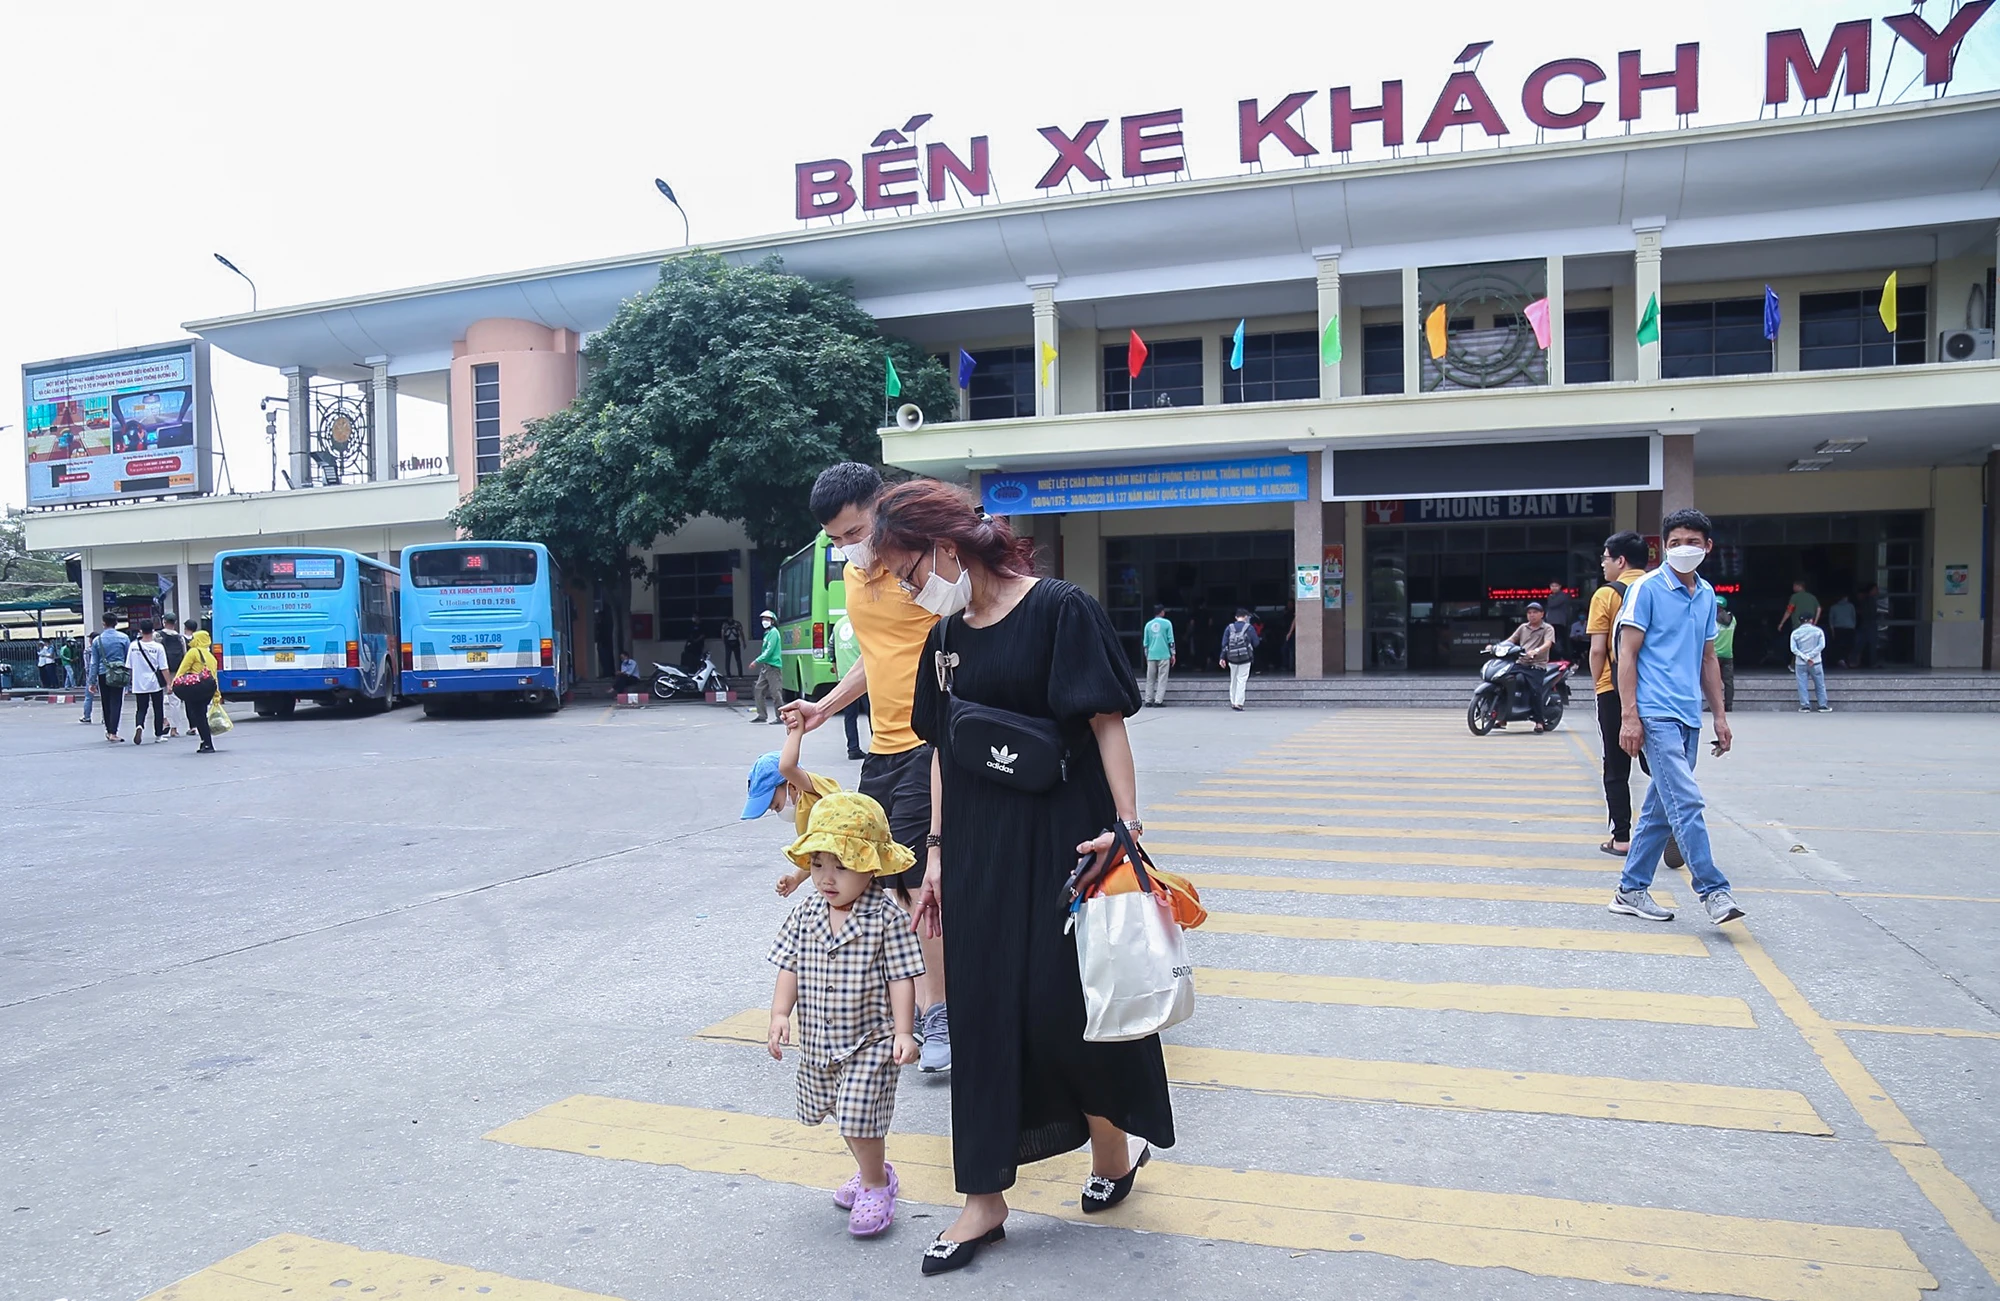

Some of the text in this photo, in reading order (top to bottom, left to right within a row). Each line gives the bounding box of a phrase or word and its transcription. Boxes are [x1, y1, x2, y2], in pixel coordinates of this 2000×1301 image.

[796, 113, 989, 219] BẾN
[1035, 108, 1184, 189] XE
[1238, 40, 1699, 163] KHÁCH
[400, 456, 442, 471] KUMHO
[1056, 477, 1068, 491] LIỆT
[1069, 475, 1085, 488] CHÀO
[1130, 473, 1146, 485] NGÀY
[1106, 491, 1115, 503] VÀ
[1116, 492, 1126, 502] 137
[1144, 488, 1160, 501] NGÀY
[1179, 485, 1187, 499] TẾ
[1188, 487, 1200, 499] LAO
[281, 636, 306, 645] 209.81
[451, 634, 467, 643] 29B
[474, 633, 502, 643] 197.08
[986, 761, 1014, 774] adidas
